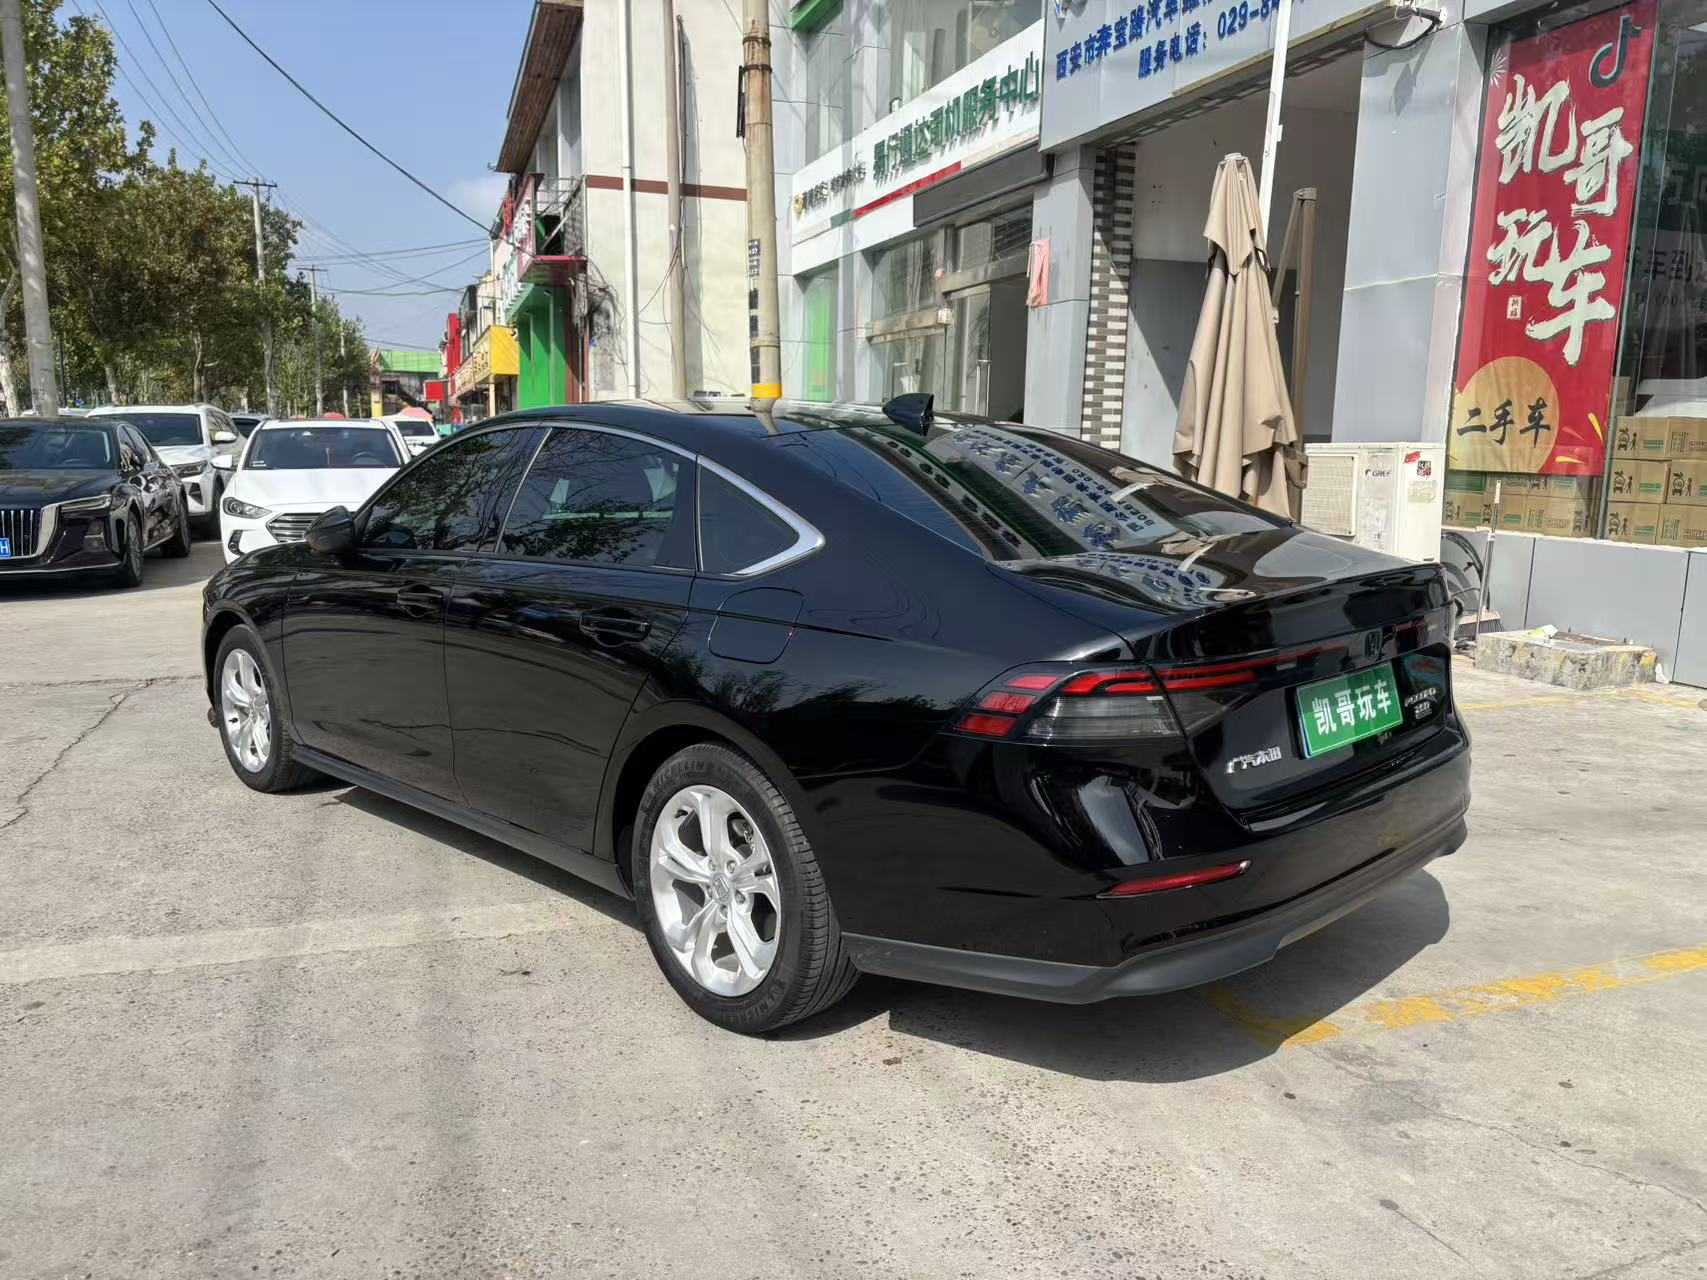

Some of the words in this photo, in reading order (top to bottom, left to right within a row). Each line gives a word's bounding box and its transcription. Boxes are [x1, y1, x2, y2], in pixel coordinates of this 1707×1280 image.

[1496, 74, 1633, 217] 凯哥
[1487, 207, 1616, 366] 玩车
[1457, 397, 1551, 449] 二手车
[1312, 680, 1392, 736] 凯哥玩车
